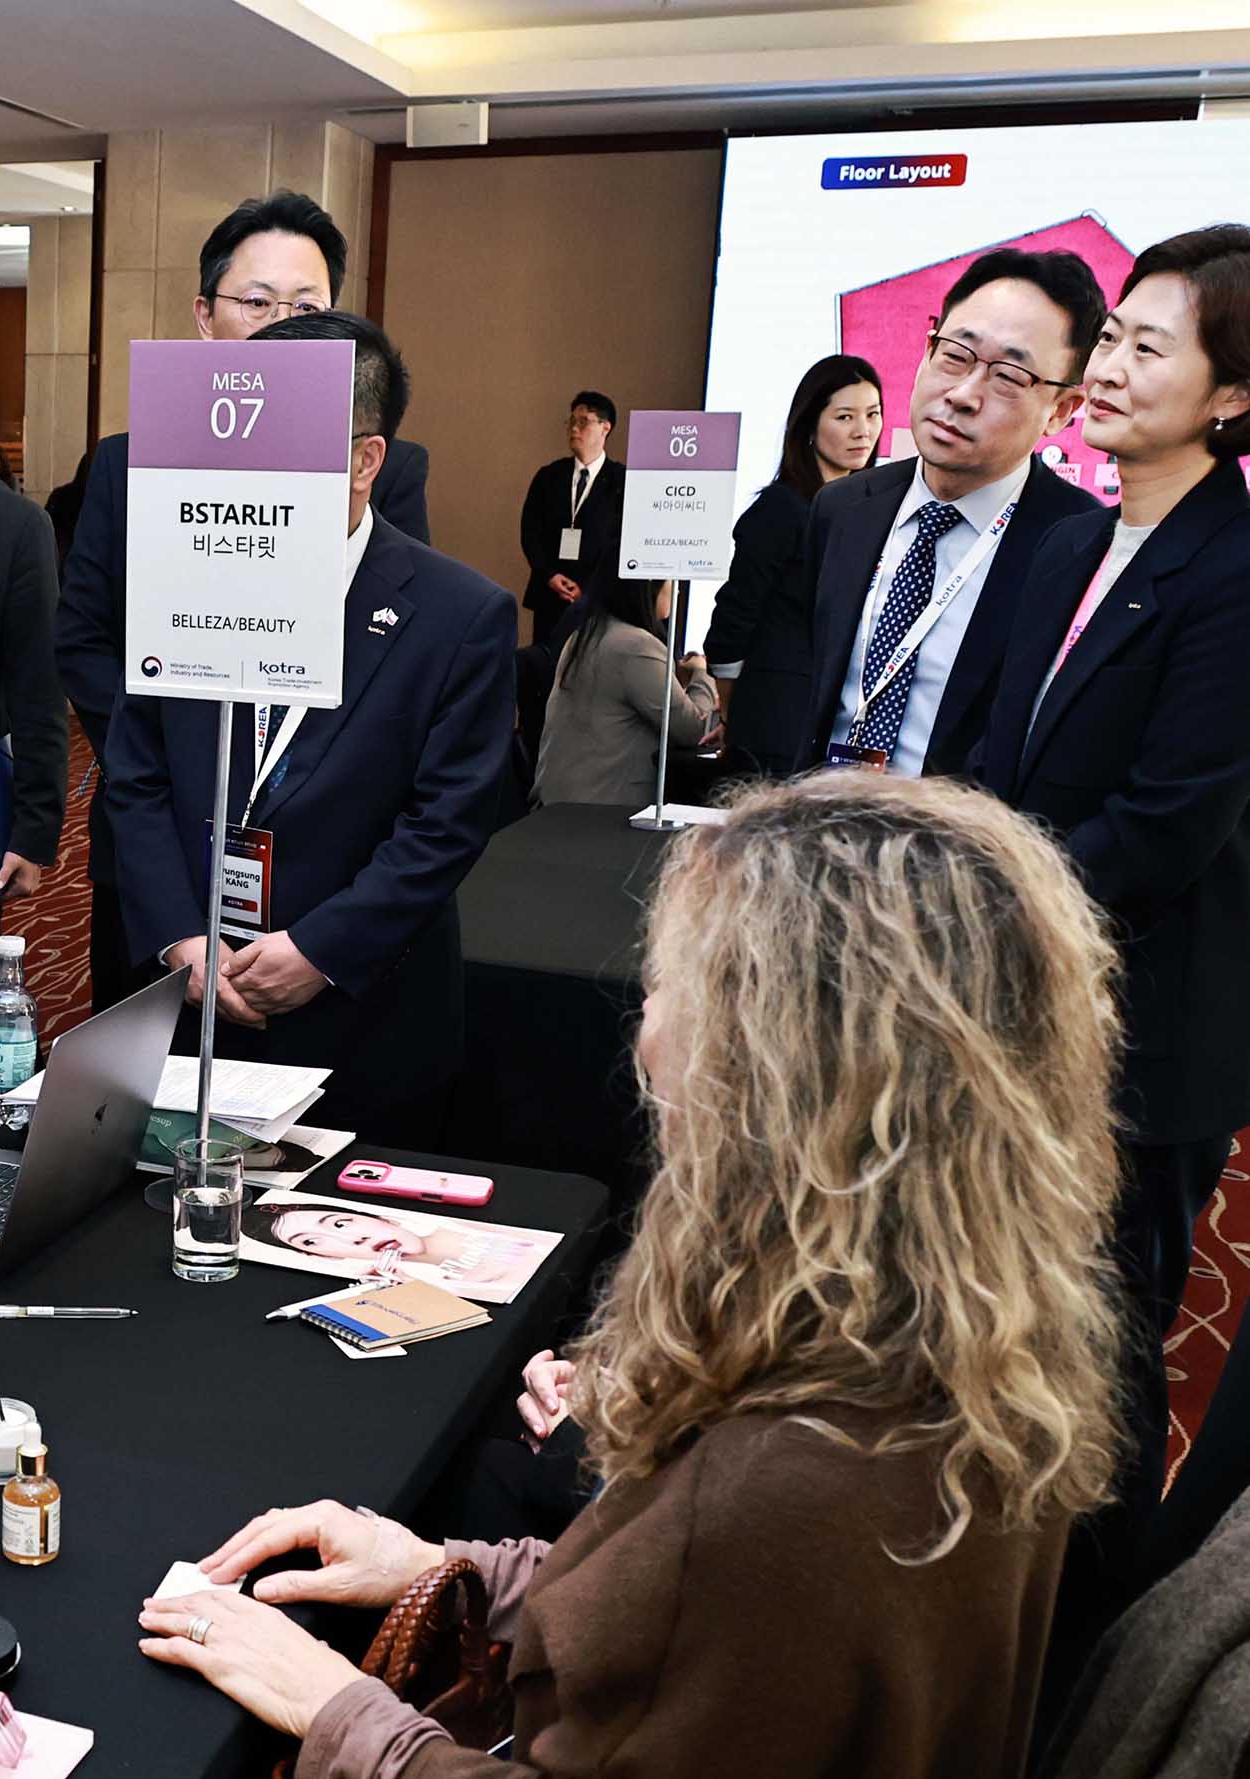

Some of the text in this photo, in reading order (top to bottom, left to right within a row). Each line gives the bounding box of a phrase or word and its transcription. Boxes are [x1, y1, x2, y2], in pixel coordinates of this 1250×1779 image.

[839, 163, 952, 183] Floor Layout
[212, 372, 265, 391] MESA
[210, 397, 265, 439] 07
[670, 425, 698, 435] MESA
[669, 437, 698, 457] 06
[665, 486, 696, 497] CICD
[179, 502, 295, 527] BSTARLIT
[193, 534, 276, 559] 비스타릿
[172, 613, 296, 633] BELLEZA/BEAUTY
[259, 660, 306, 675] kotra
[225, 877, 250, 889] KANG
